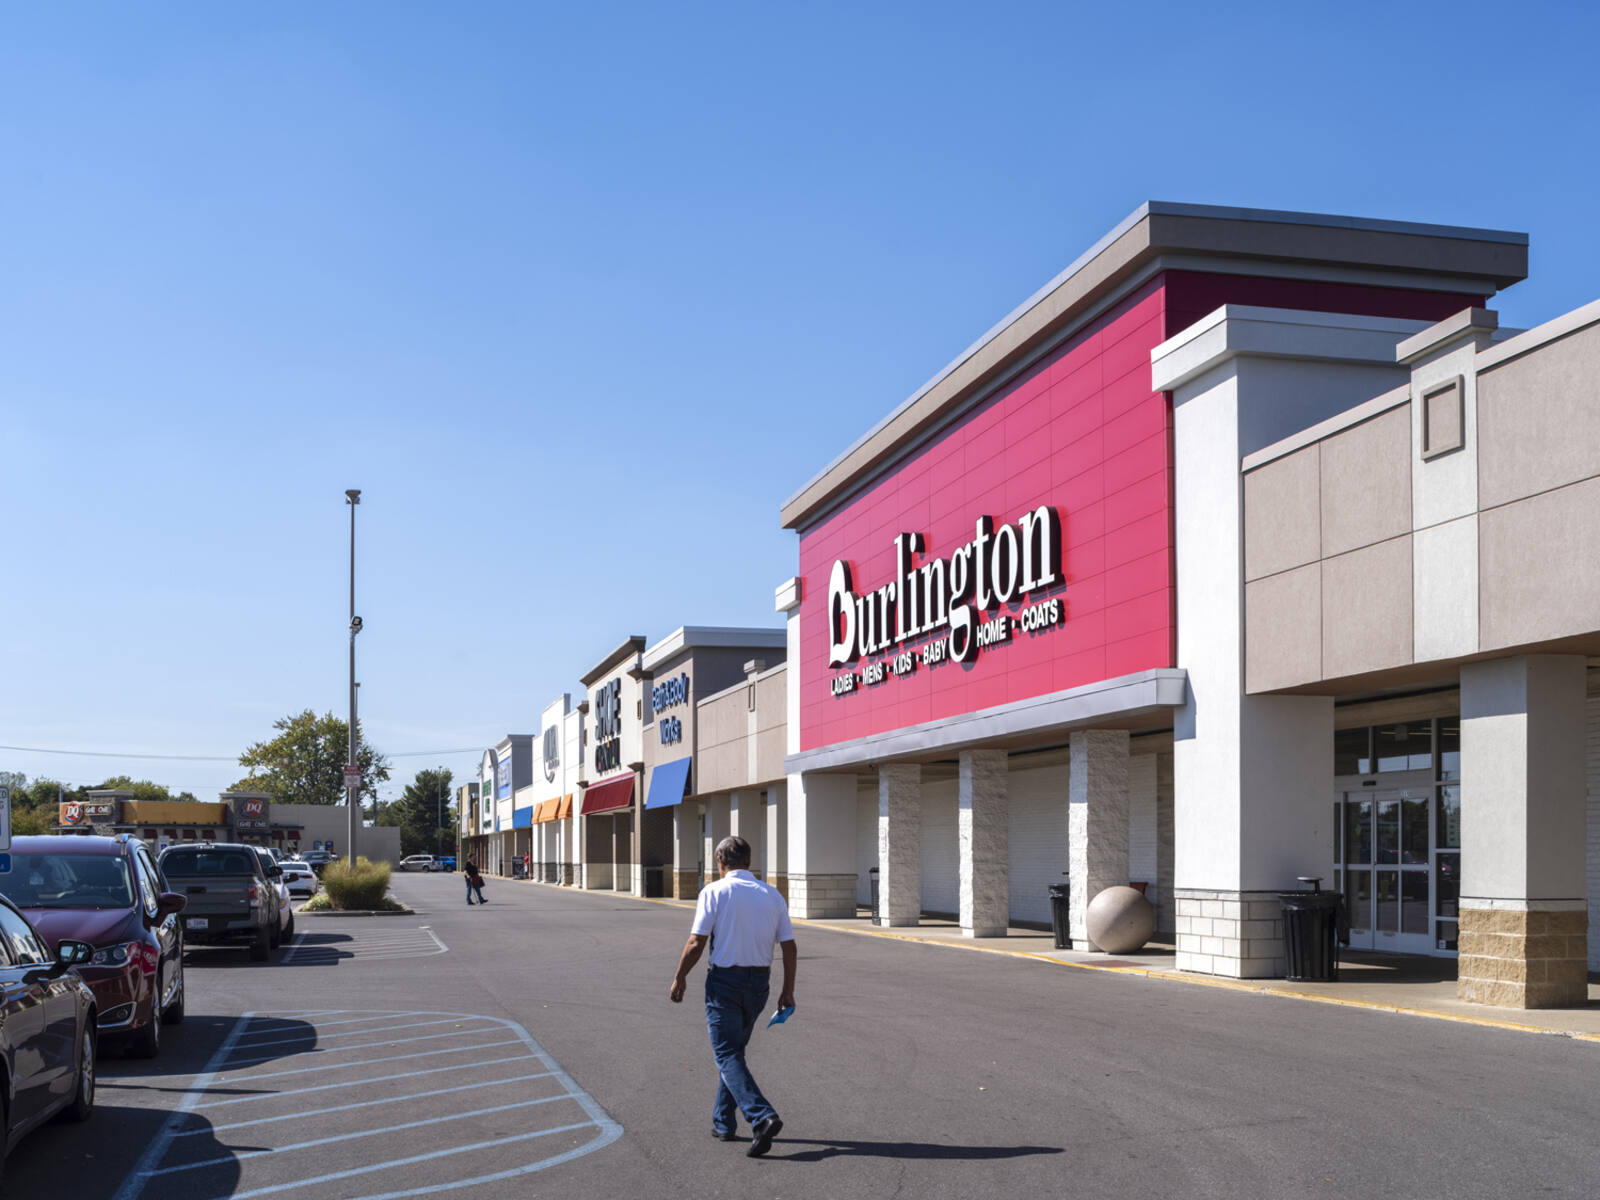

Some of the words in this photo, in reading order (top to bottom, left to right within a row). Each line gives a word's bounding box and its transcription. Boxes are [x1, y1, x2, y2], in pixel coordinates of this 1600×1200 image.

[828, 505, 1057, 667] Burlington
[830, 672, 853, 696] LADIES
[862, 662, 883, 686] MENS
[893, 651, 912, 676] KIDS
[923, 638, 947, 666] BABY
[976, 617, 1007, 648] HOME
[1021, 598, 1059, 633] COATS
[595, 677, 621, 741] SHOE
[67, 805, 79, 818] DQ
[247, 803, 262, 813] DQ
